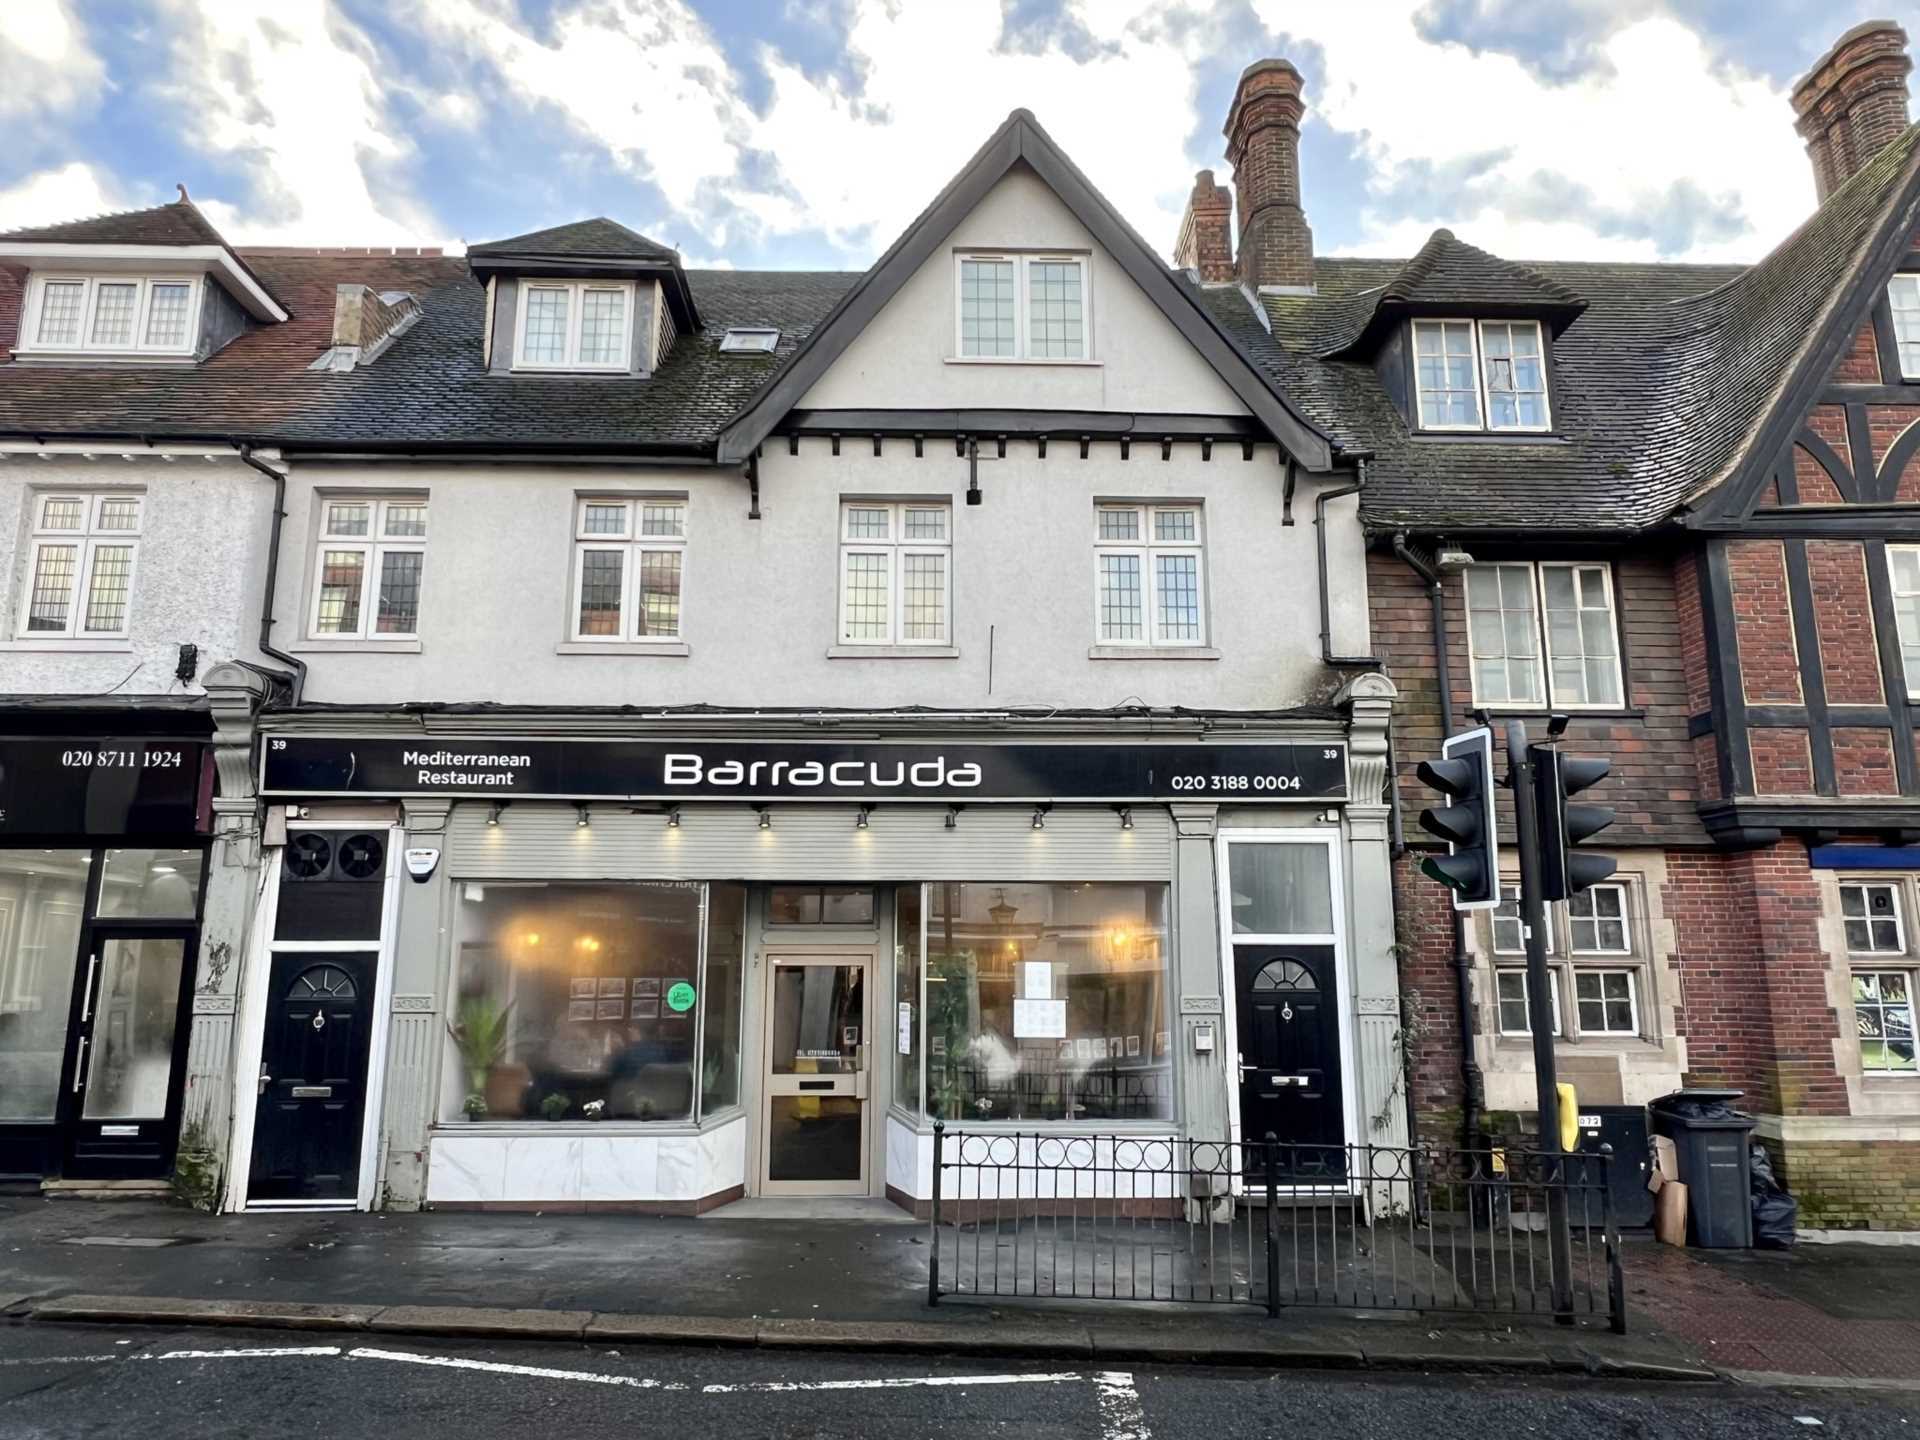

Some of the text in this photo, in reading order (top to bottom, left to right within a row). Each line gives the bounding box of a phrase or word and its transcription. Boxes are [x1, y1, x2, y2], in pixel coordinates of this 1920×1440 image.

[271, 740, 287, 750] 39
[61, 750, 182, 768] 020 8711 1924
[403, 750, 531, 767] Mediterranean
[1323, 749, 1338, 760] 39
[417, 769, 515, 786] Restaurant
[663, 753, 982, 787] Barracuda
[1171, 775, 1301, 790] 020 3188 0004
